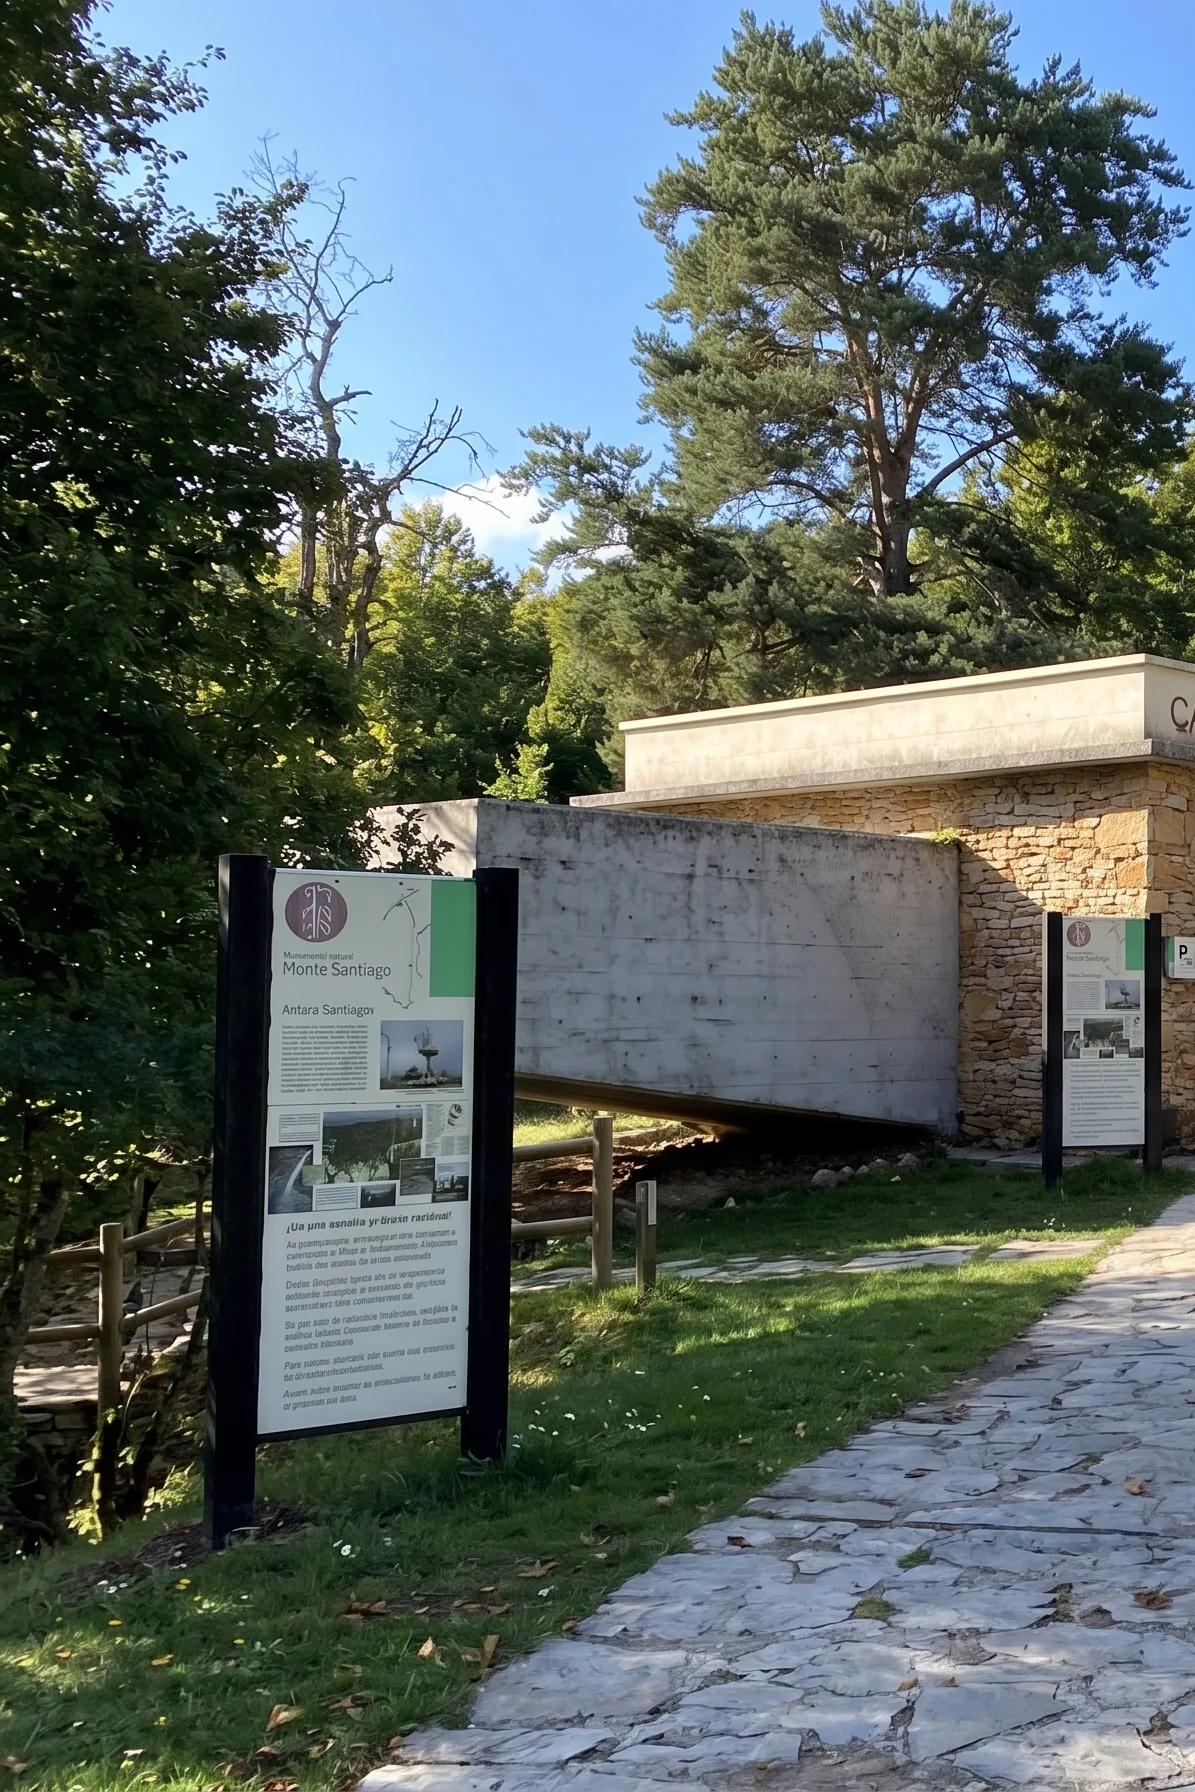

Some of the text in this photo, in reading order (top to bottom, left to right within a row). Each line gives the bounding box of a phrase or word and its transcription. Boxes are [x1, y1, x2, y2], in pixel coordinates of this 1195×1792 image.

[1179, 944, 1188, 960] P
[282, 961, 392, 981] Monte Santiago
[282, 1004, 319, 1016] Antara
